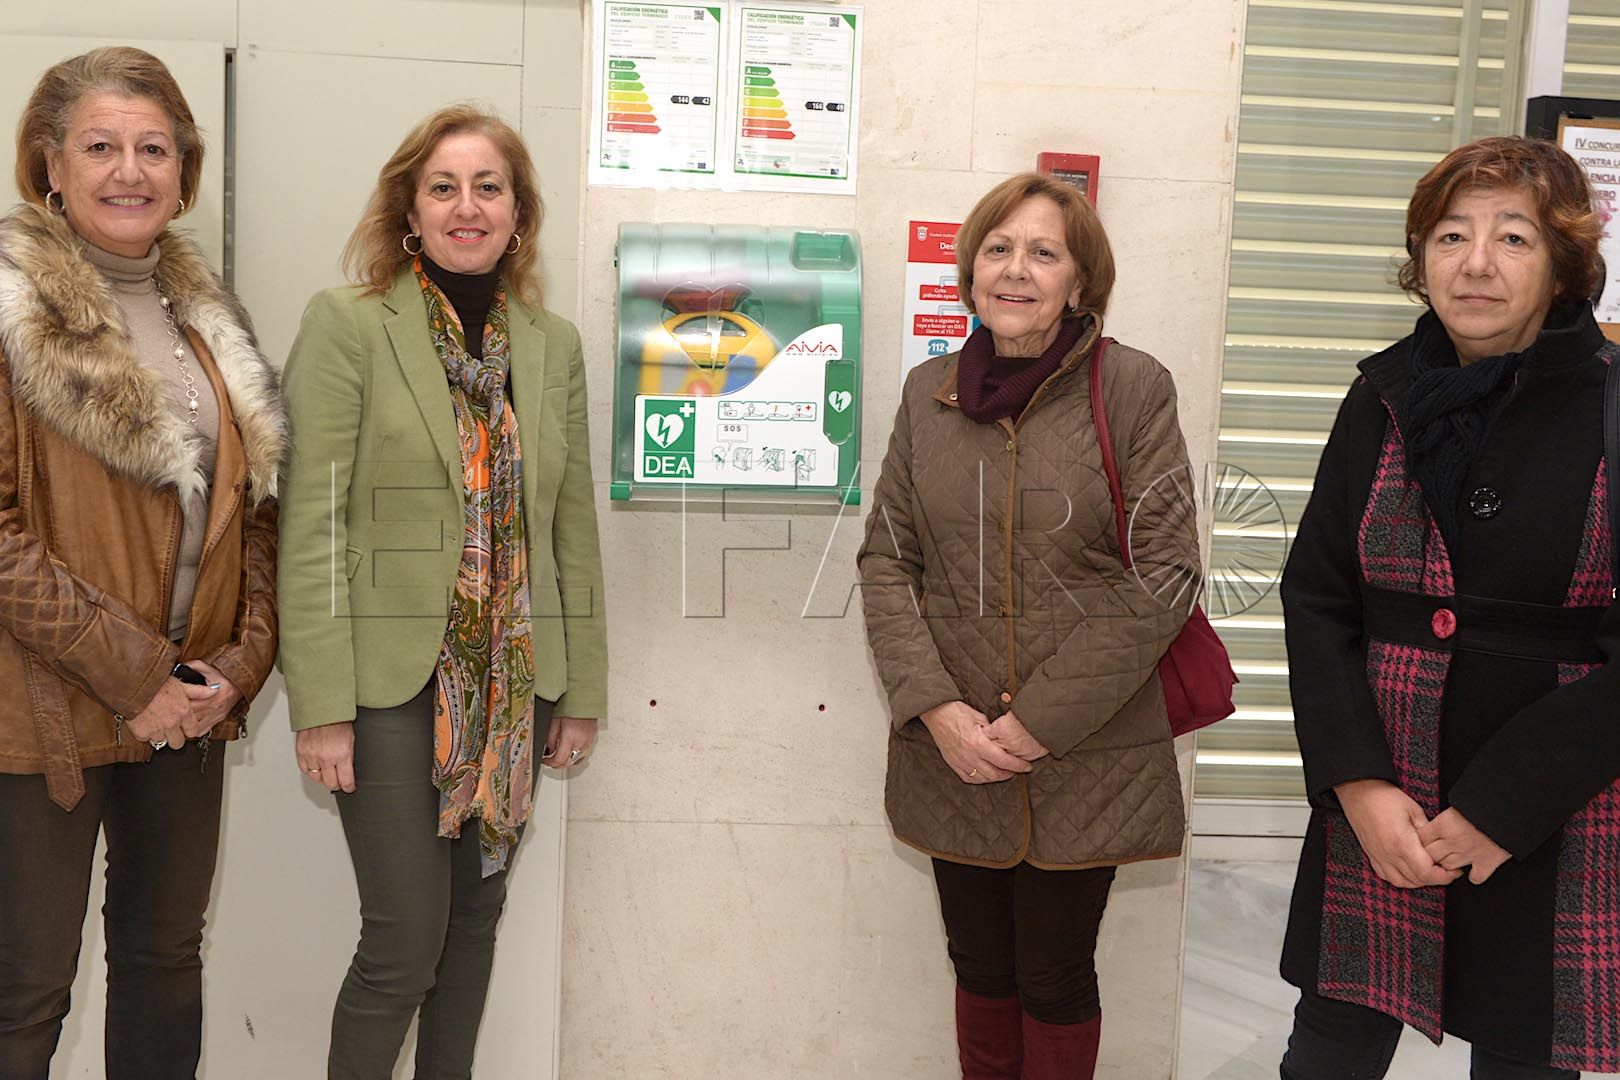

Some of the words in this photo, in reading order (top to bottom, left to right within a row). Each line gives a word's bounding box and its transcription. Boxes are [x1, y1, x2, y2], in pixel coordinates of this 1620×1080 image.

[1575, 138, 1587, 147] IV
[1580, 157, 1611, 166] CONTRA
[931, 343, 945, 352] 112
[645, 456, 692, 474] DEA
